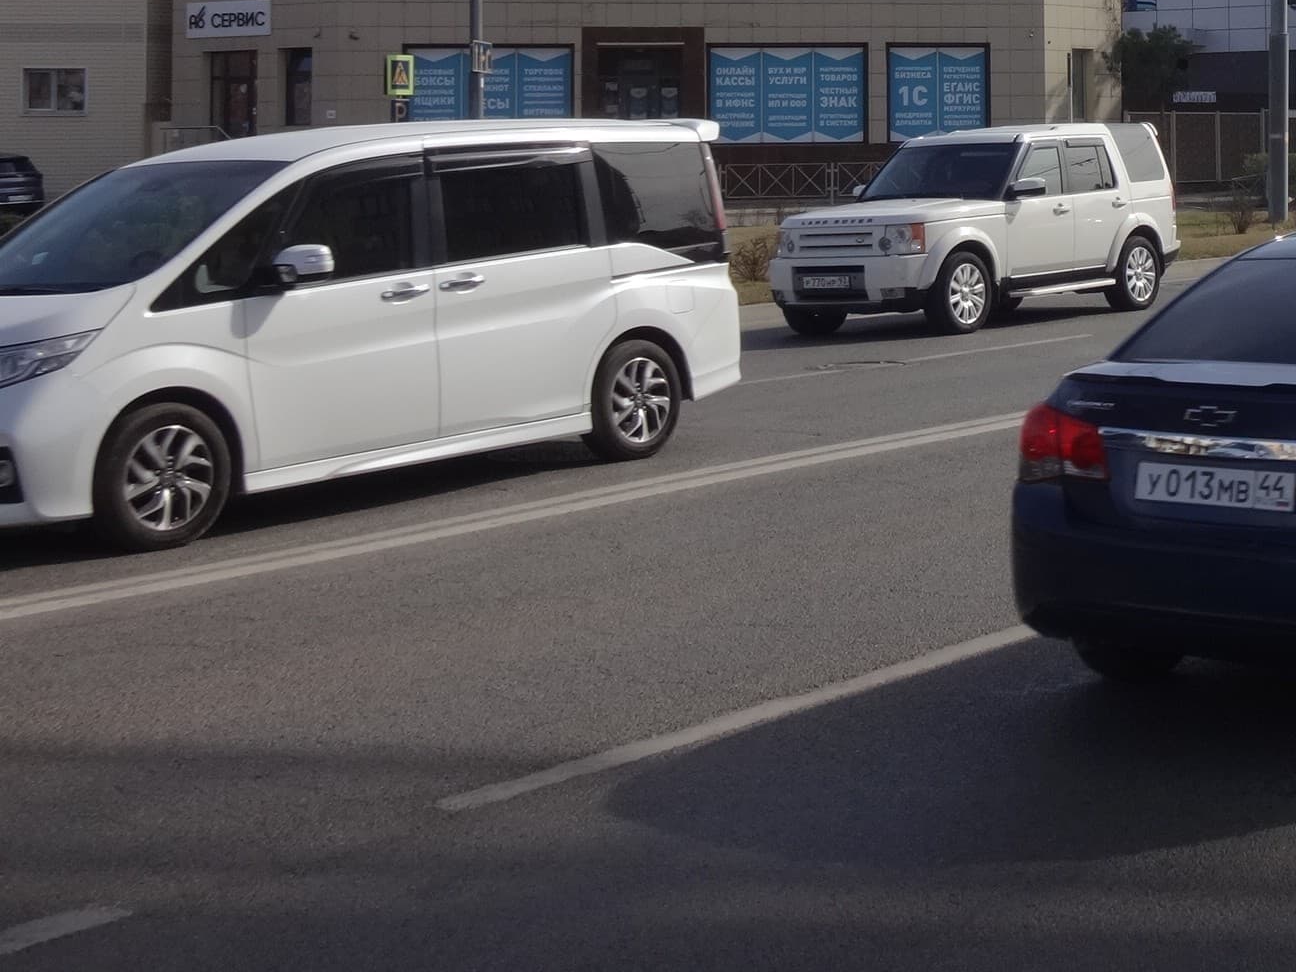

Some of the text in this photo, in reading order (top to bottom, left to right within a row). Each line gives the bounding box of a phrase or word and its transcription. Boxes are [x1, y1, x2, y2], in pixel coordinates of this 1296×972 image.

[211, 11, 265, 28] СЕРВИС
[716, 66, 755, 75] ОНЛАЙН
[895, 71, 931, 79] БИЗНЕСА
[716, 77, 755, 86] КАССЫ
[769, 76, 807, 85] УСЛУГИ
[820, 86, 857, 94] ЧЕСТНЫЙ
[944, 83, 980, 92] ЕГАИС
[899, 85, 928, 106] 1С
[944, 93, 980, 104] ФГИС
[414, 97, 455, 106] ЯЩИКИ
[820, 97, 857, 107] ЗНАК
